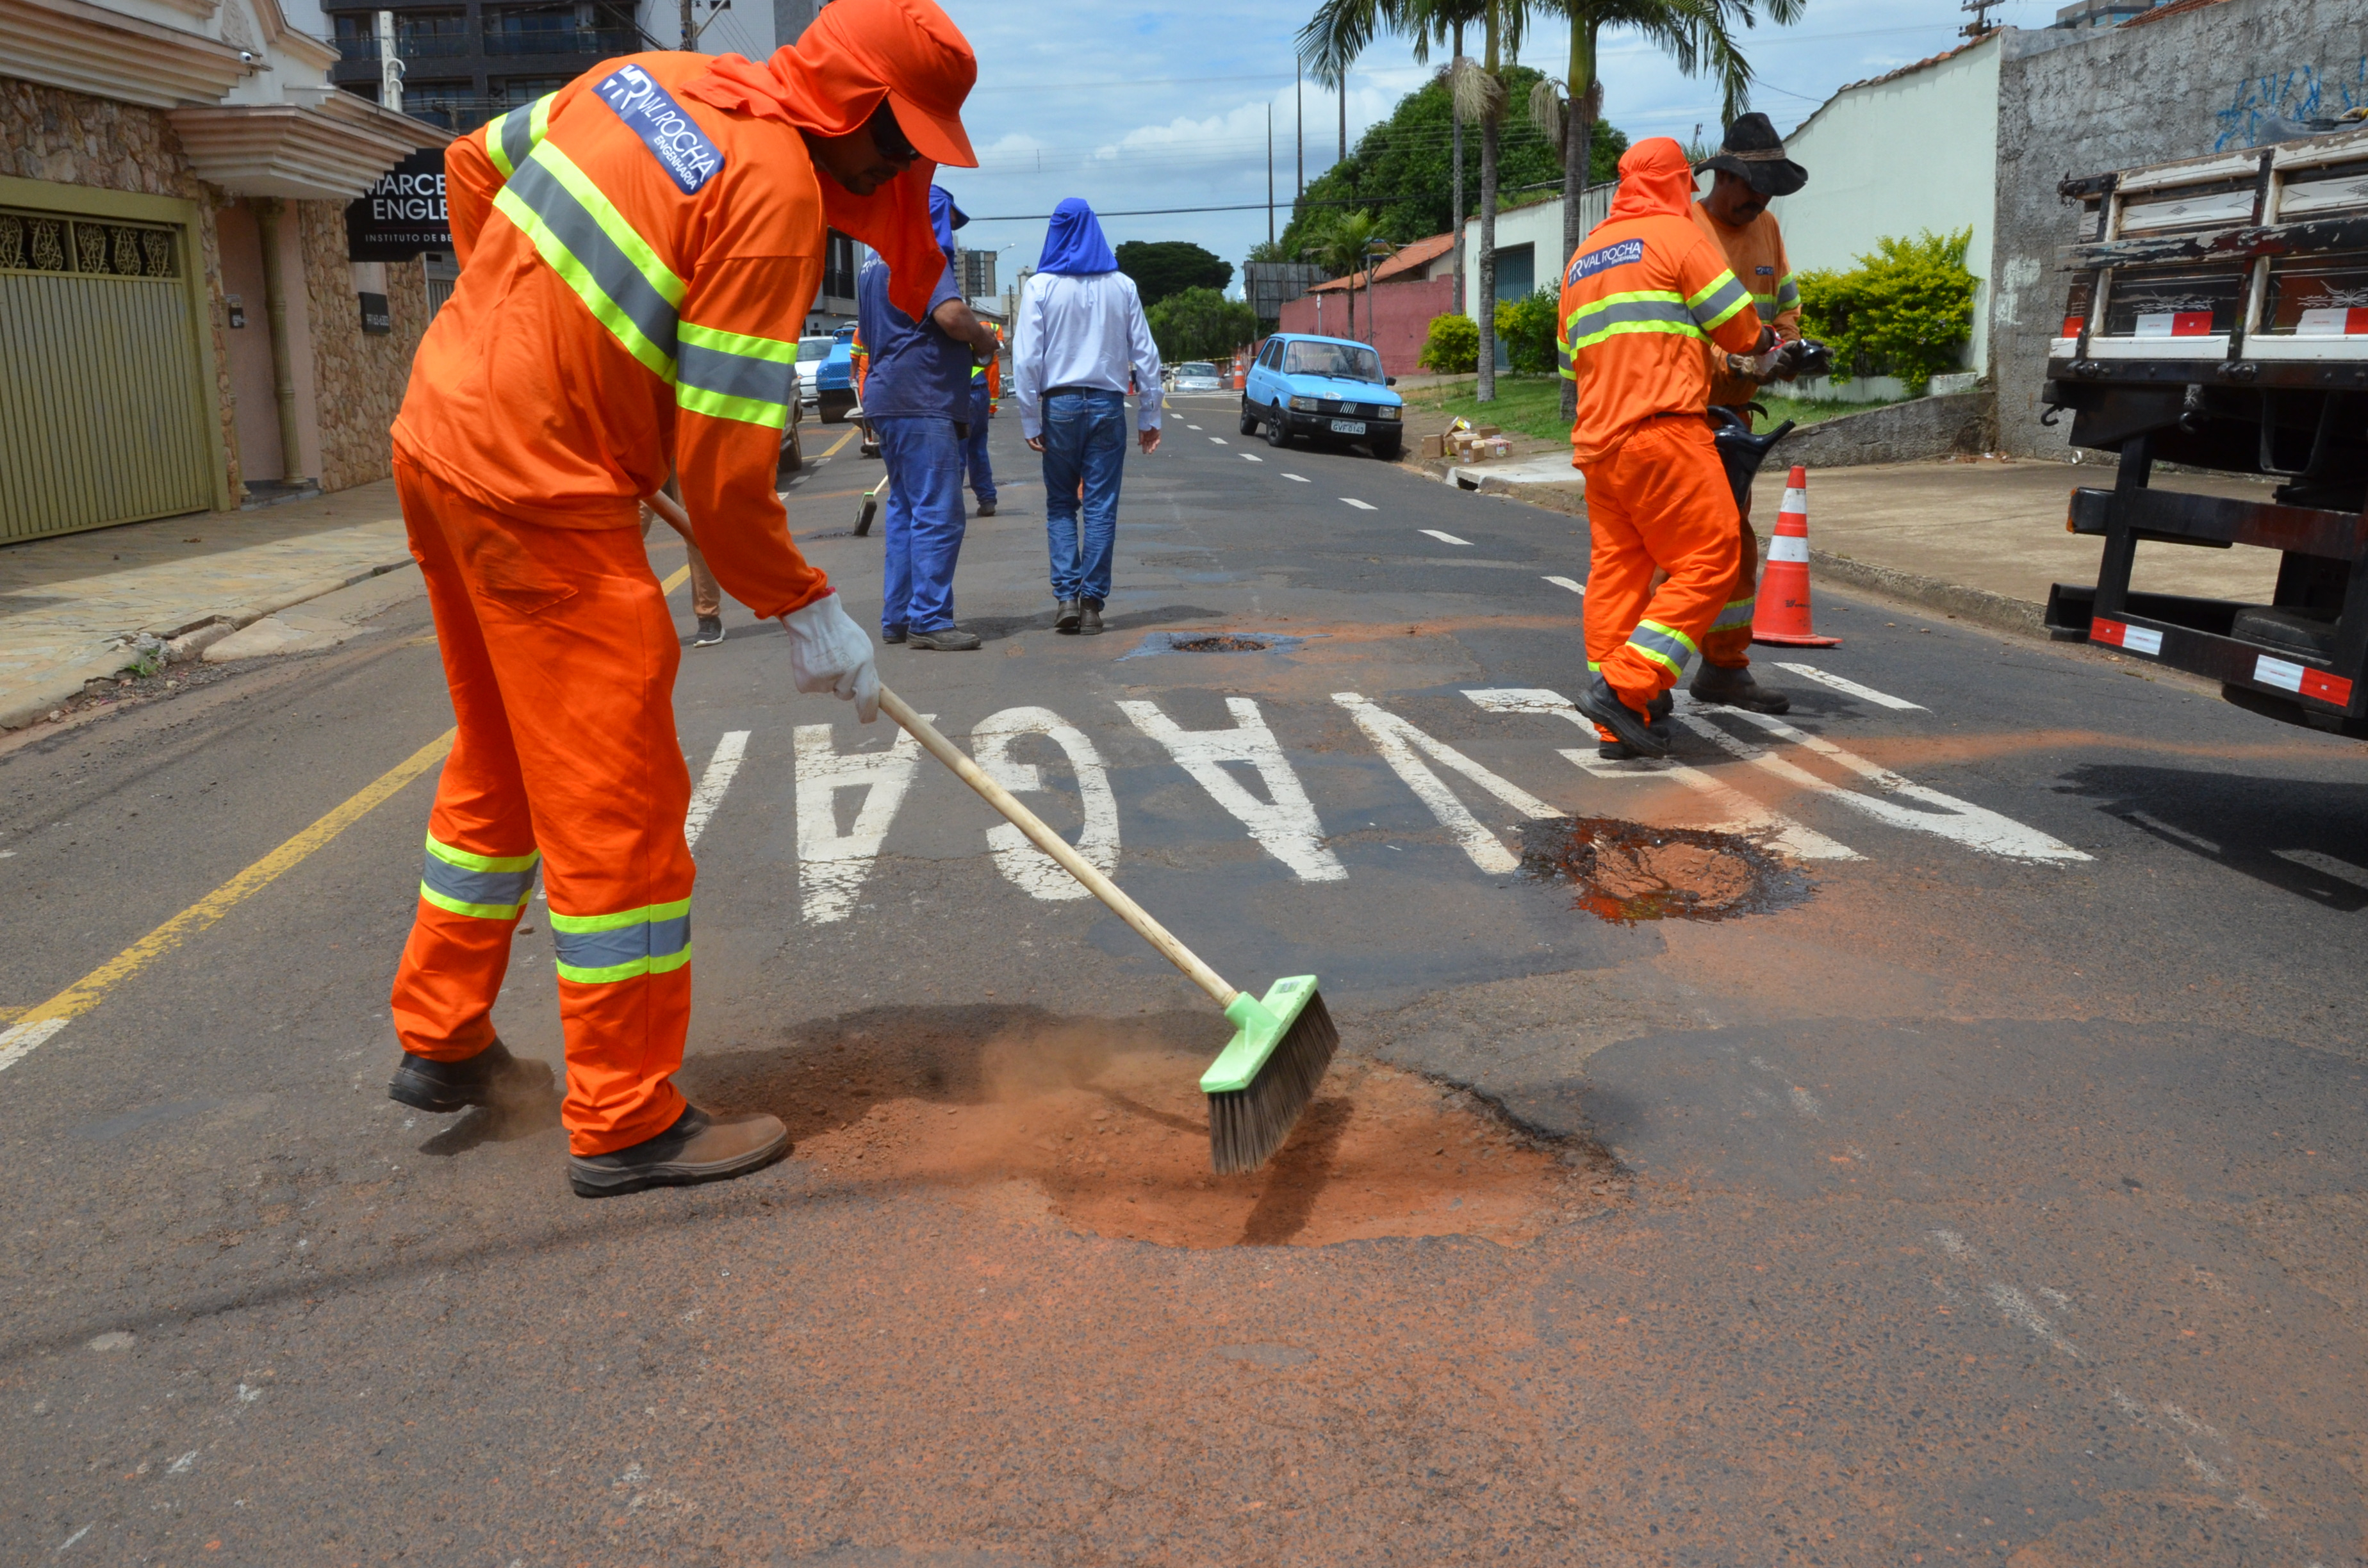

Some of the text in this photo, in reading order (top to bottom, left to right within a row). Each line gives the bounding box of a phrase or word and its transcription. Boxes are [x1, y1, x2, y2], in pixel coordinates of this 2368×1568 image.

[638, 92, 667, 118] VAL
[651, 110, 715, 183] ROCHA
[654, 135, 698, 190] ENGENHARIA
[365, 234, 420, 242] INSTITUTO
[1583, 254, 1601, 269] VAL
[1602, 242, 1641, 264] ROCHA
